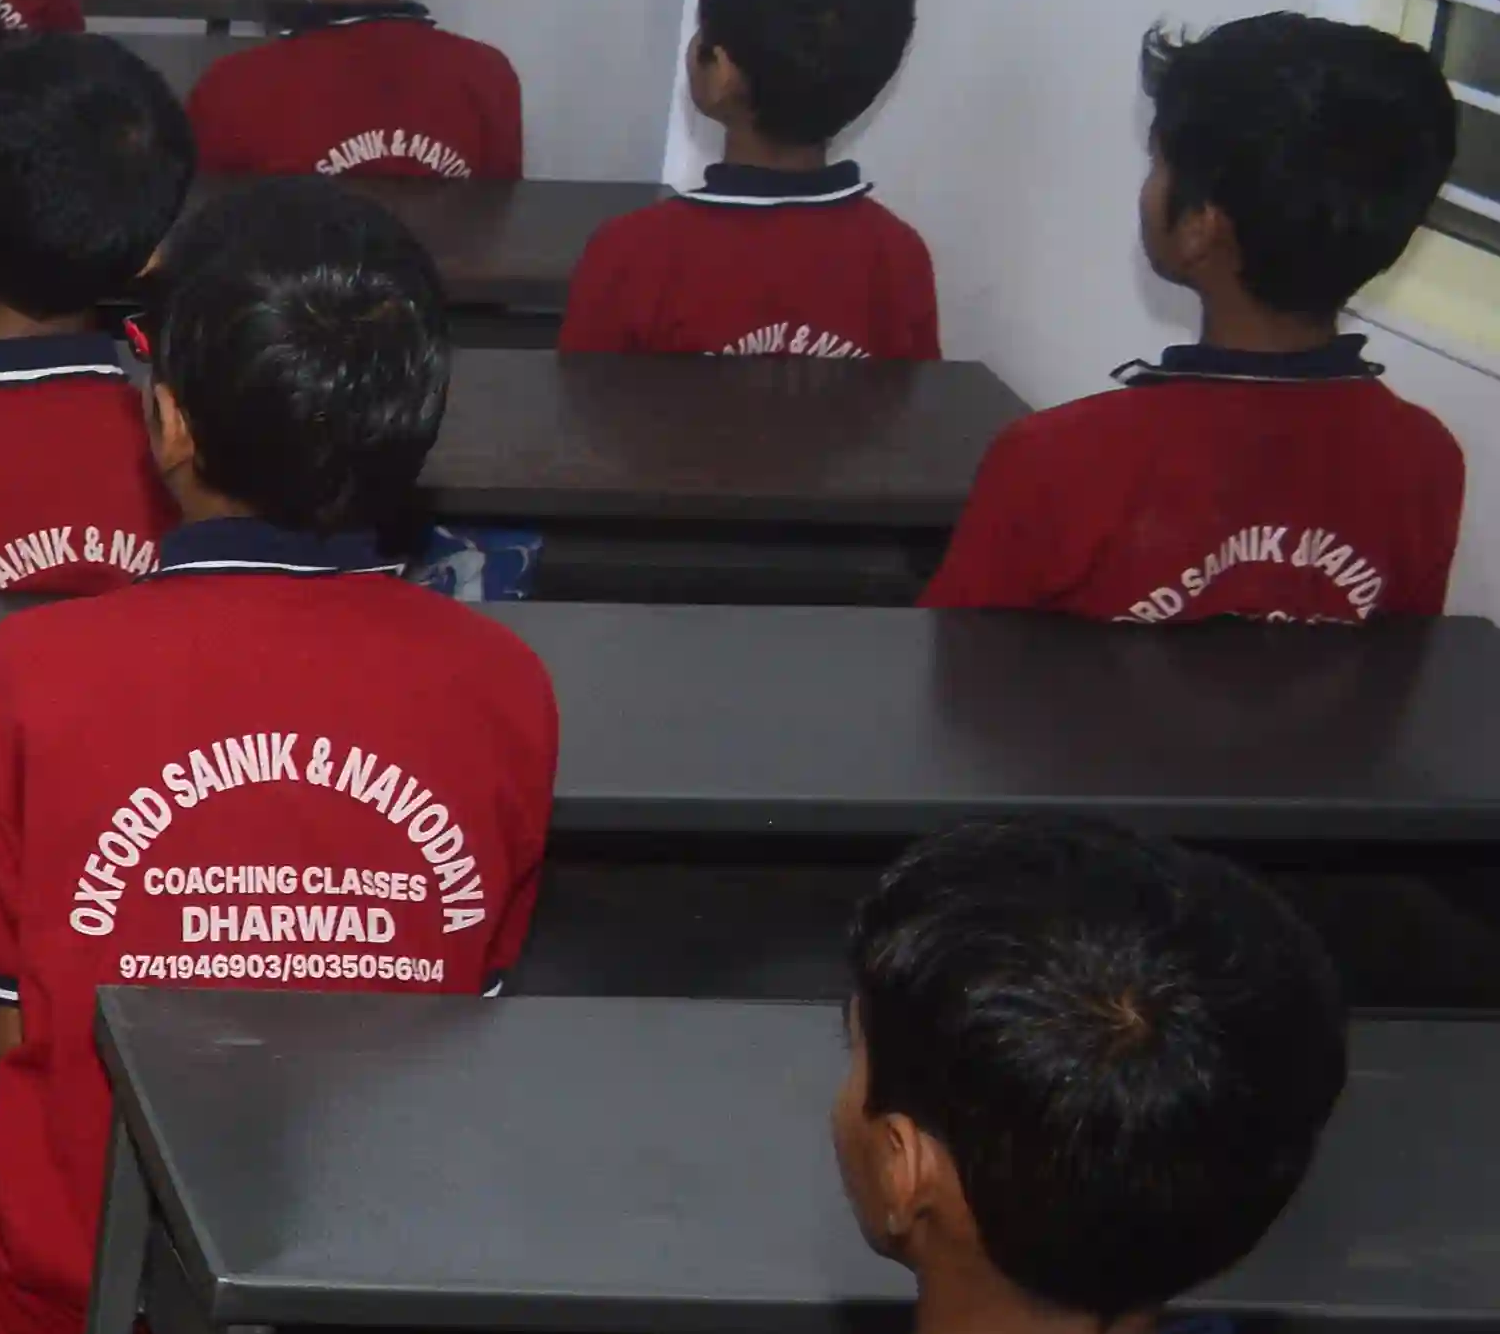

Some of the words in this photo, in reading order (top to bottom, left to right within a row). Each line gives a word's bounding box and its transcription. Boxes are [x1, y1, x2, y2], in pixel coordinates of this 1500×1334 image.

[315, 129, 388, 176] SAINIK
[391, 128, 407, 156] &
[789, 324, 810, 354] &
[84, 526, 104, 562] &
[1181, 526, 1287, 596] SAINIK
[69, 786, 173, 937] OXFORD
[162, 733, 299, 808] SAINIK
[306, 737, 333, 788] &
[335, 746, 485, 934] NAVODAYA
[143, 866, 297, 895] COACHING
[301, 867, 427, 902] CLASSES
[181, 906, 396, 944] DHARWAD
